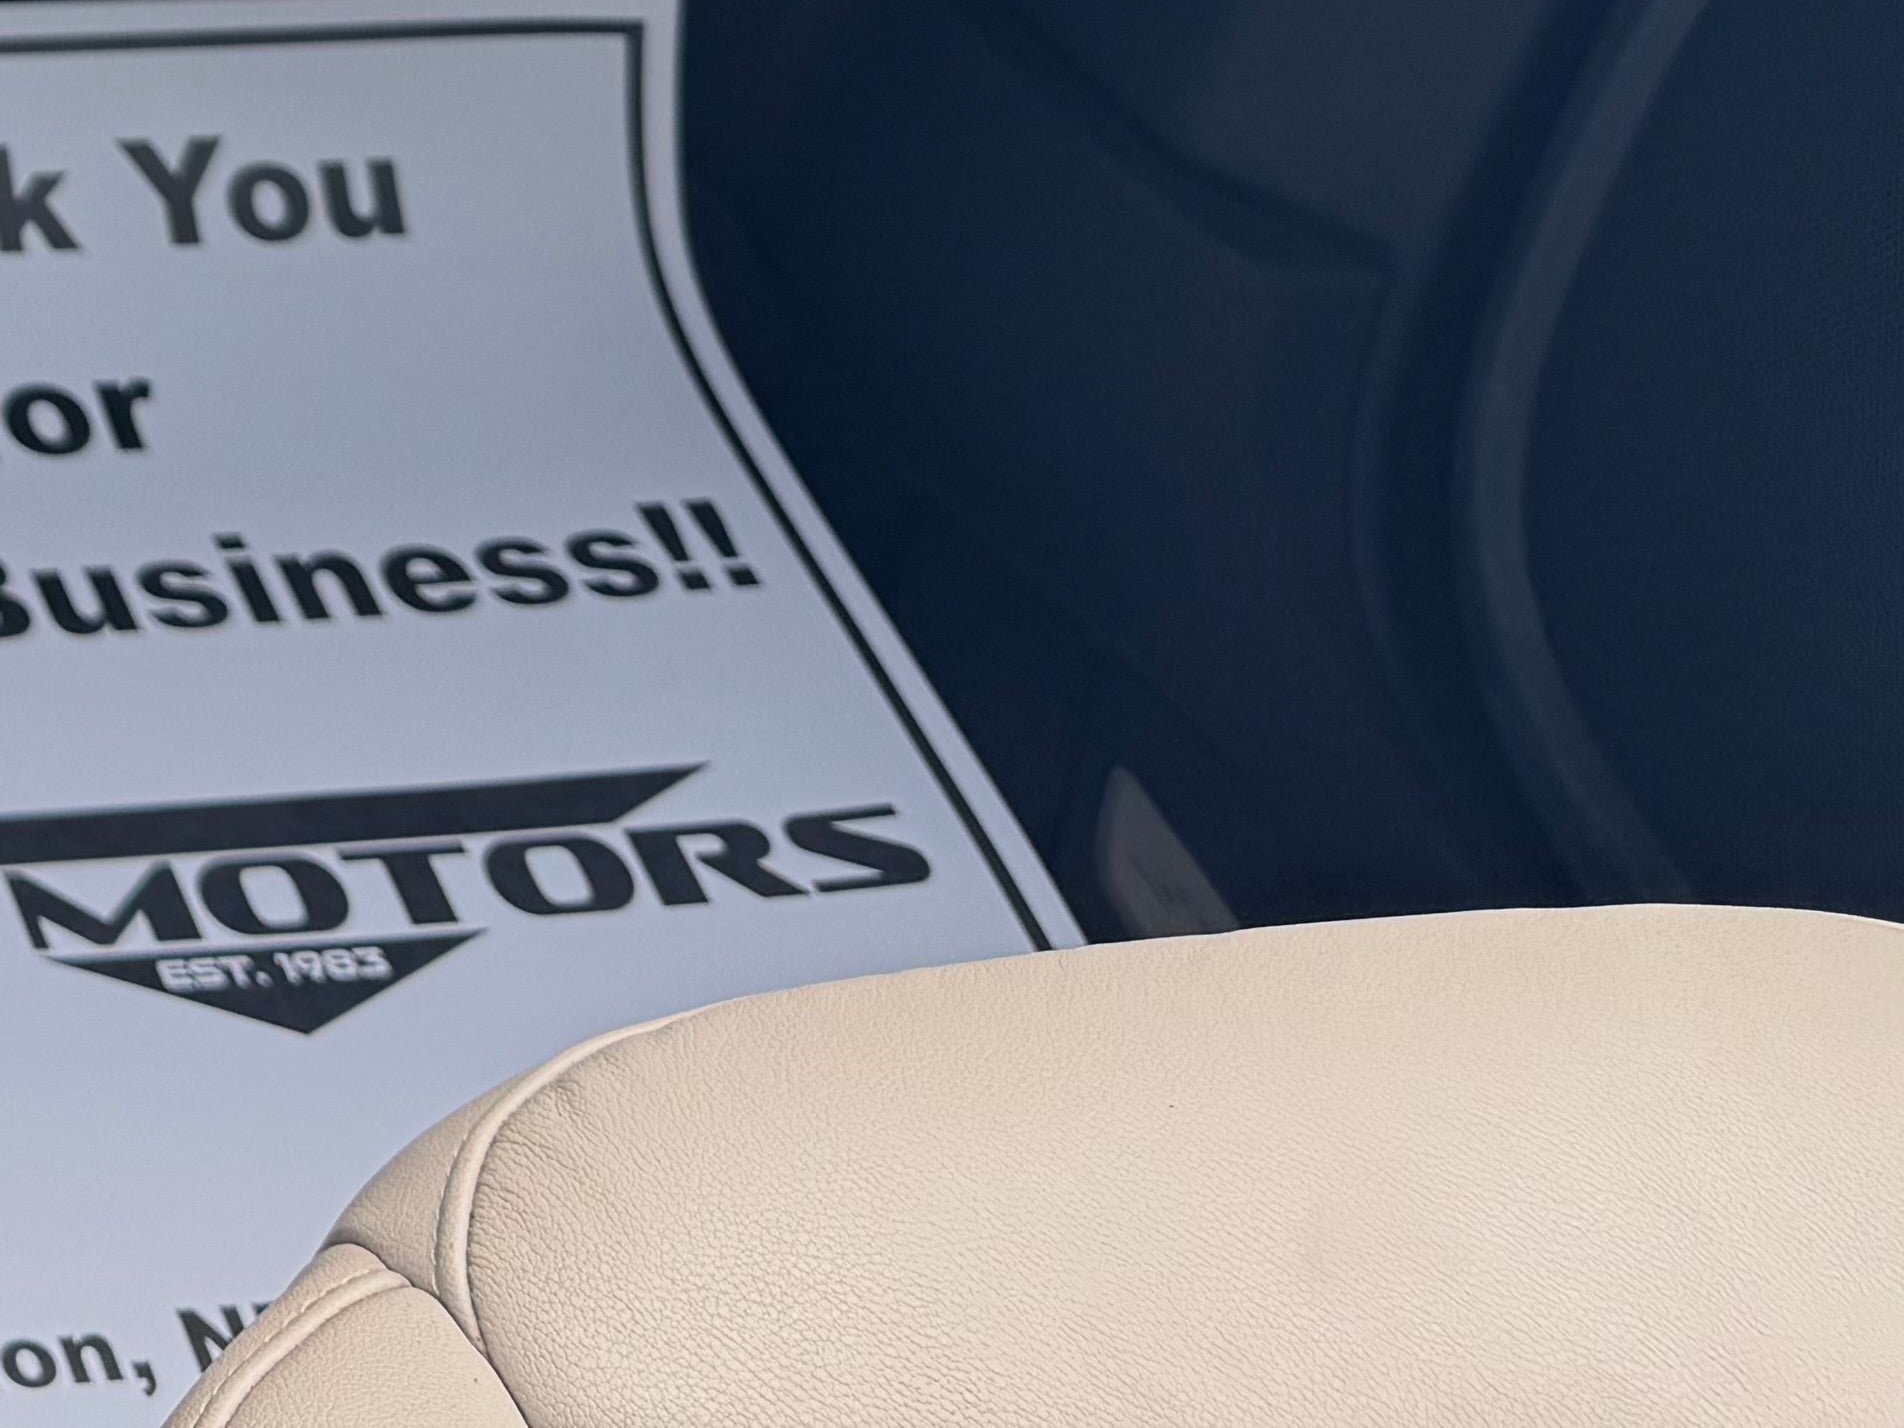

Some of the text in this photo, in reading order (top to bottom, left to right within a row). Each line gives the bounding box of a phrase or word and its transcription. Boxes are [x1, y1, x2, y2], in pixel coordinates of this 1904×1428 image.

[117, 135, 409, 247] You
[1, 804, 933, 949] MOTORS
[155, 945, 391, 992] EST. 1983
